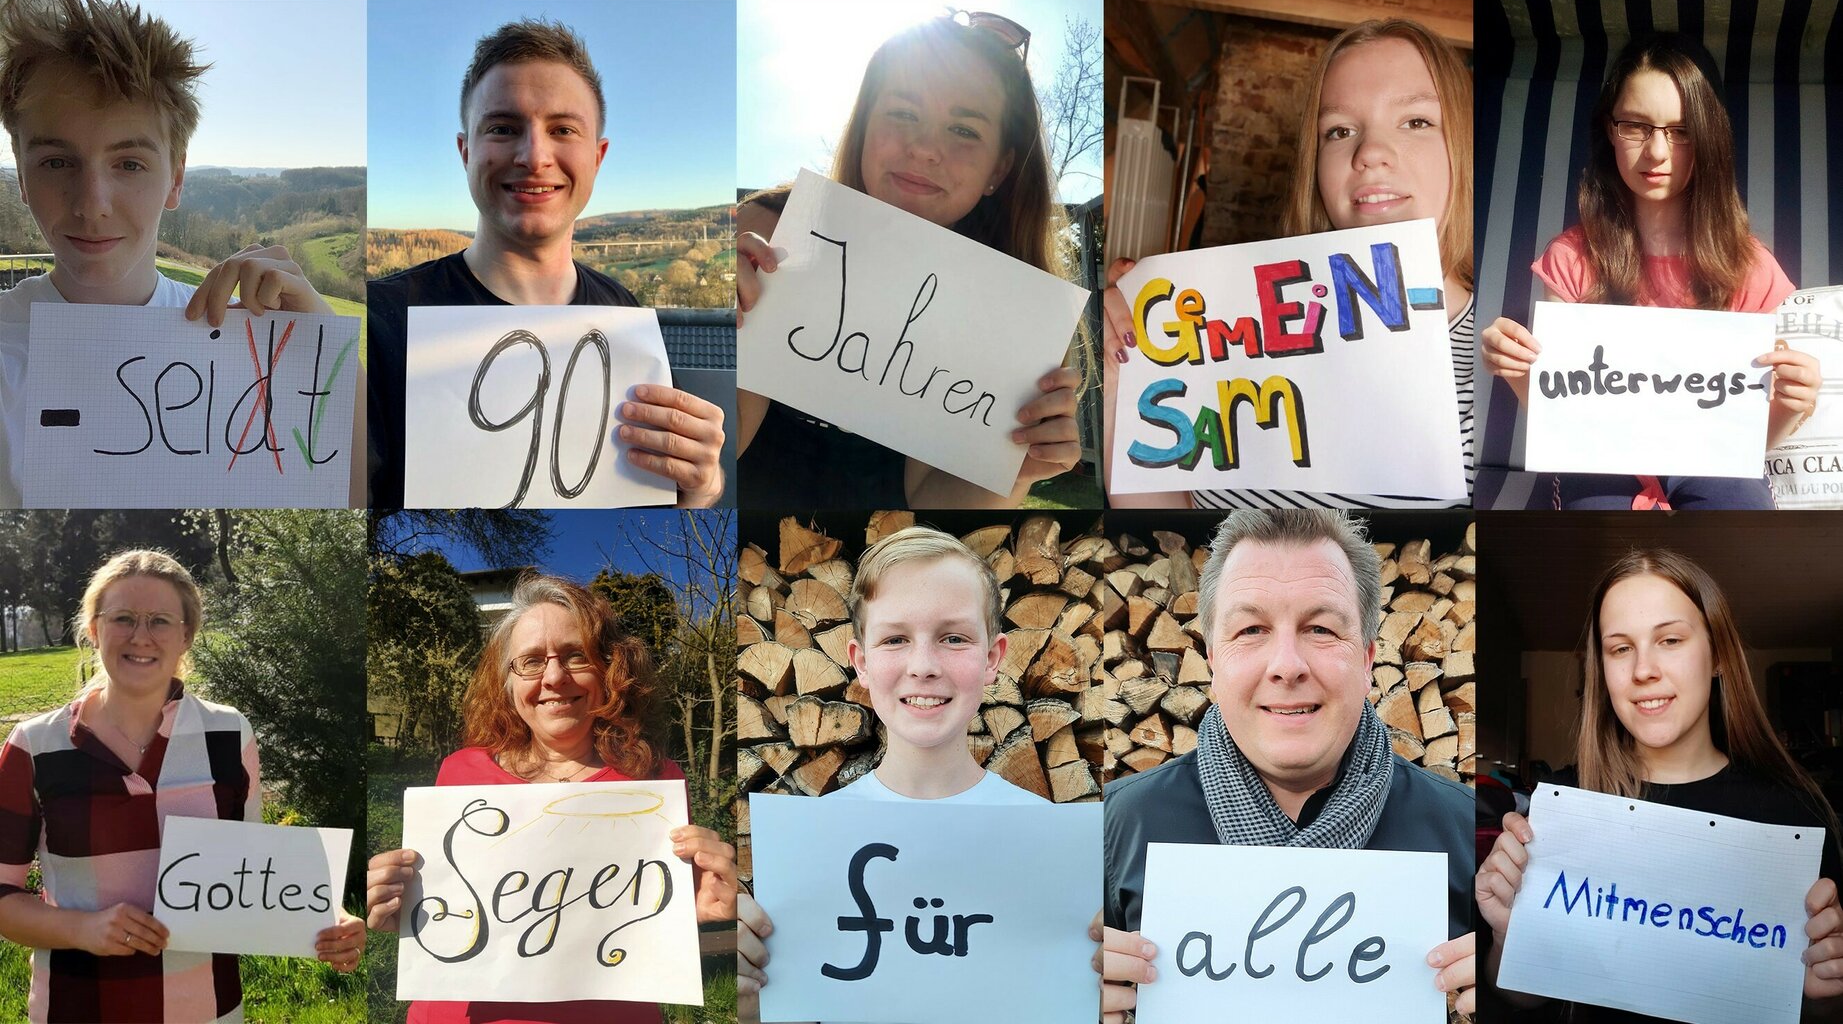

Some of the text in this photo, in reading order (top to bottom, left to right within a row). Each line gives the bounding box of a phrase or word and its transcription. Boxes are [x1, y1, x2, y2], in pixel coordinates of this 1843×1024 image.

[788, 230, 994, 427] Jahren
[468, 328, 611, 508] 90
[1539, 345, 1765, 410] unterwegs-
[1765, 457, 1796, 476] ICA
[158, 852, 331, 913] Gottes
[410, 799, 674, 968] Segen
[821, 843, 993, 981] für
[1543, 869, 1787, 950] Mitmenschen
[1176, 886, 1390, 983] alle
